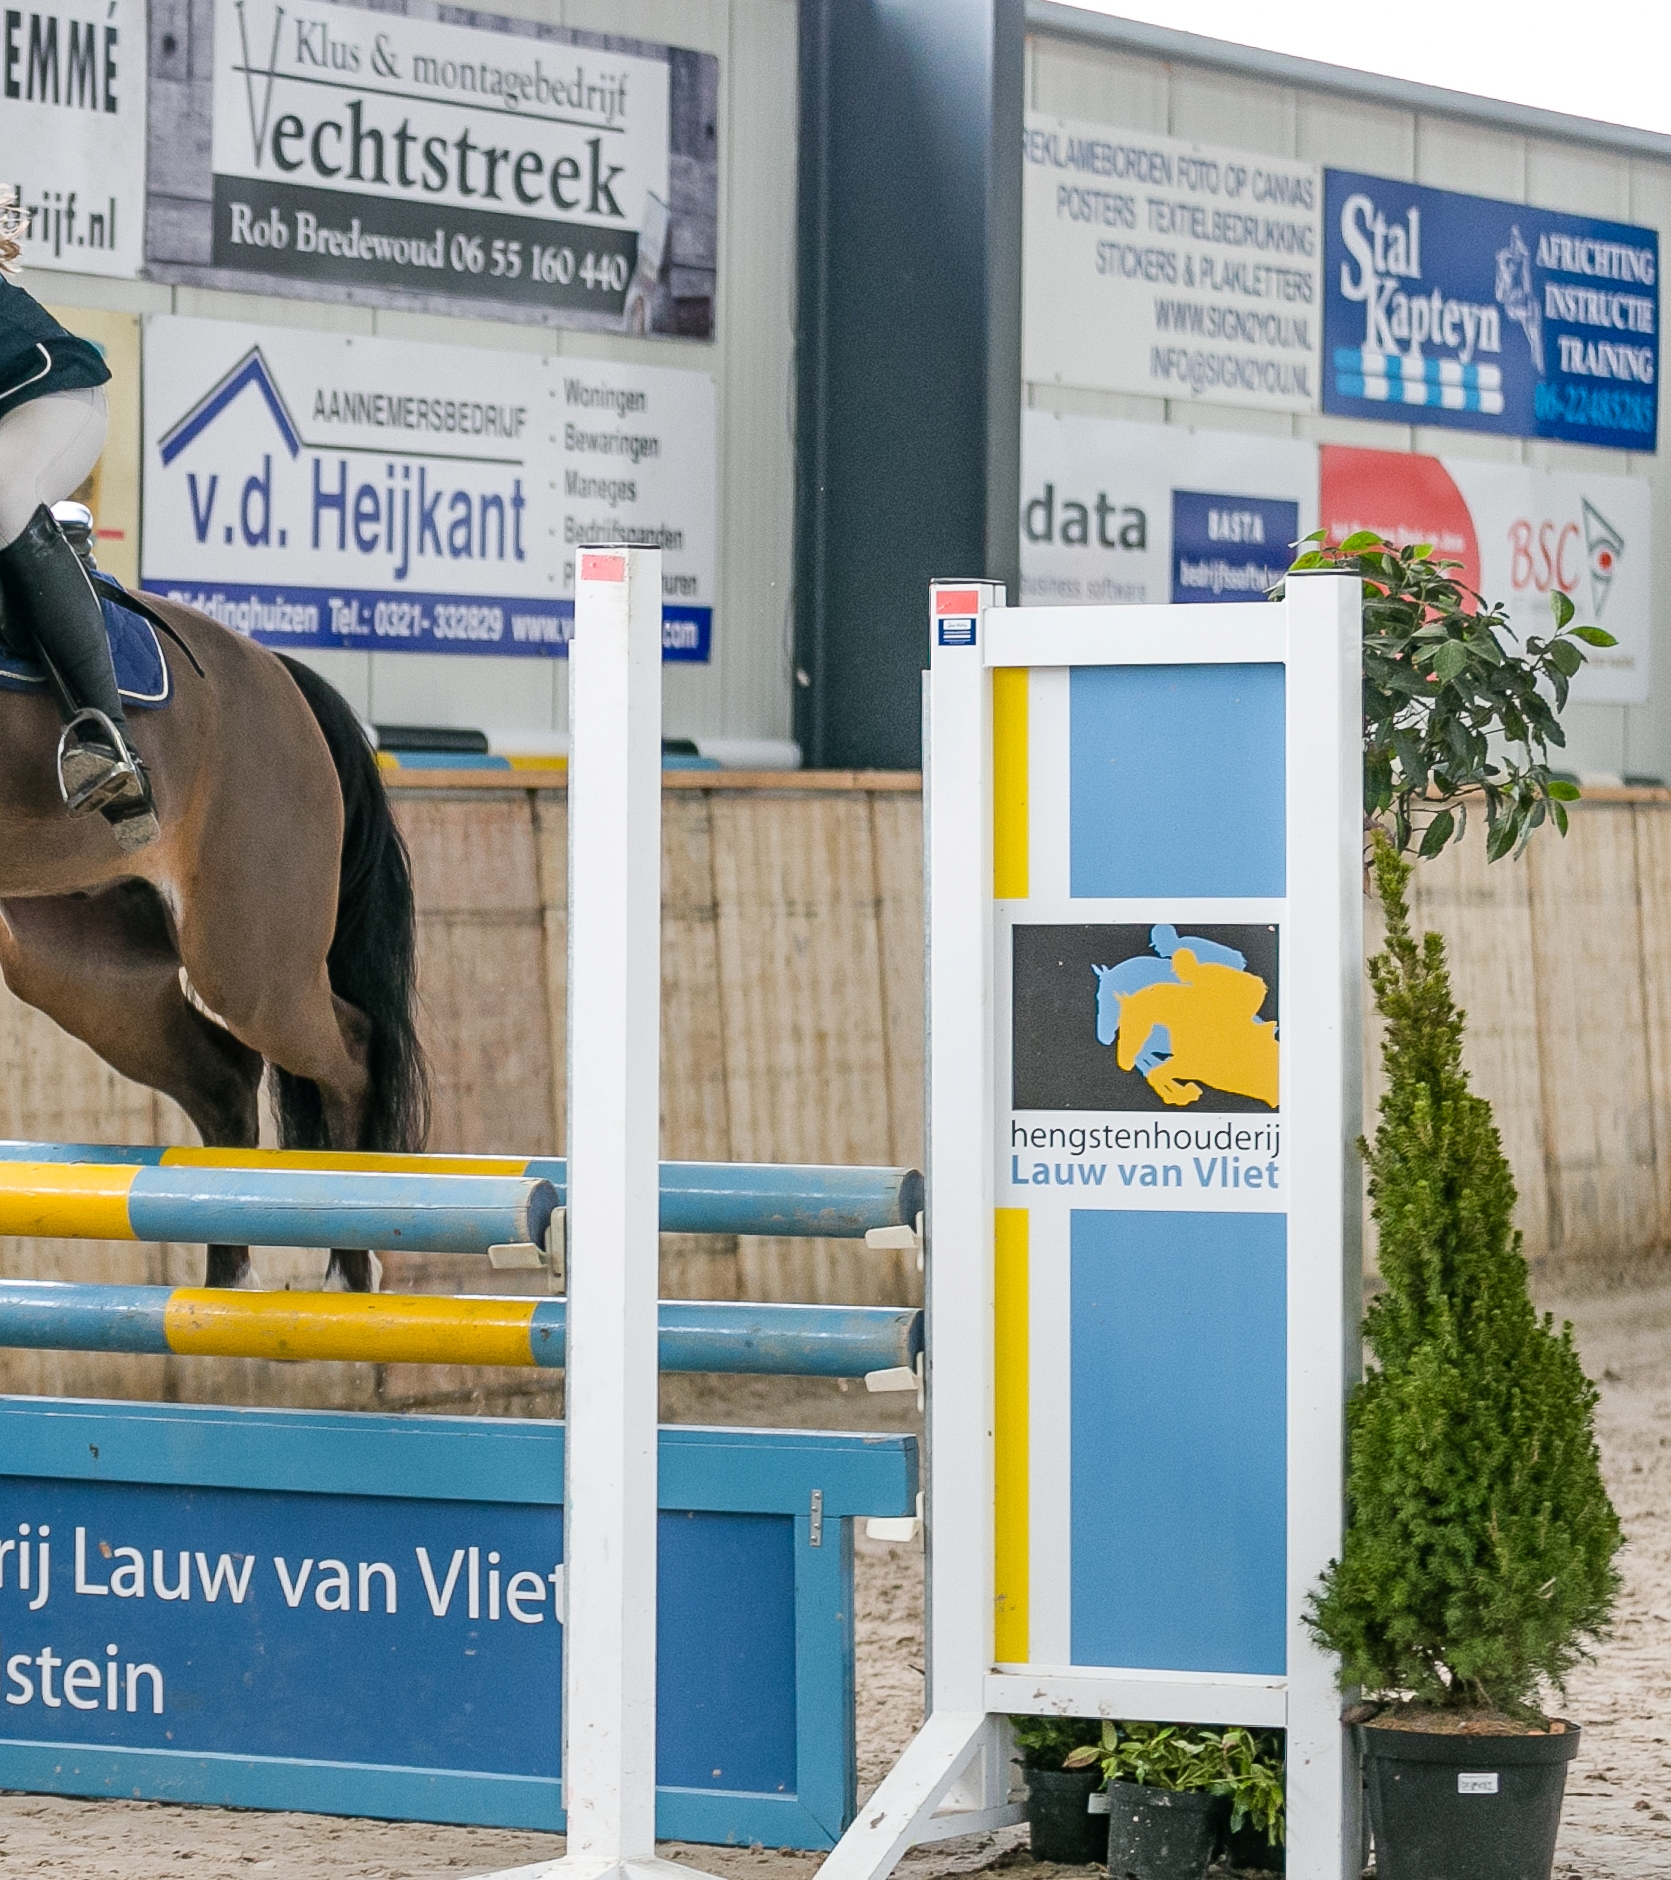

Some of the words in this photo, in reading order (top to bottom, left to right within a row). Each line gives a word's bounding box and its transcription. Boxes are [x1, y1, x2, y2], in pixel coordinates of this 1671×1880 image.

[294, 17, 362, 73] Klus
[371, 34, 402, 79] &
[413, 54, 629, 124] montagebedrijf
[1057, 185, 1135, 230] POSTERS
[1179, 156, 1218, 195] FOTO
[1225, 163, 1246, 198] OP
[1252, 169, 1314, 211] CANVAS
[229, 202, 290, 251] Rob
[295, 210, 445, 271] Bredewoud
[450, 234, 484, 274] 06
[491, 240, 522, 279] 55
[531, 245, 574, 285] 160
[579, 253, 627, 292] 440
[1095, 239, 1177, 285] STICKERS
[1200, 255, 1313, 304] PLAKLETTERS
[1340, 193, 1422, 302] Stal
[1536, 231, 1656, 286] AFRICHTING
[1364, 278, 1501, 366] Kapteyn
[1545, 281, 1655, 334] INSTRUCTIE
[1558, 334, 1655, 385] TRAINING
[313, 389, 527, 438] AANNEMERSBEDRIJF
[564, 378, 646, 418] Woningen
[565, 422, 659, 464] Bewaringen
[565, 469, 636, 508] Maneges
[187, 455, 287, 547] v.d.
[312, 459, 526, 581] Heijkant
[1023, 482, 1147, 551] data
[1509, 518, 1581, 595] BSC
[1011, 1120, 1280, 1158] hengstenhouderij
[1011, 1155, 1107, 1186] Lauw
[1118, 1163, 1182, 1188] van
[1193, 1156, 1280, 1189] Vliet
[74, 1526, 255, 1604] Lauw
[273, 1557, 398, 1615] van
[415, 1546, 563, 1625] Vliet
